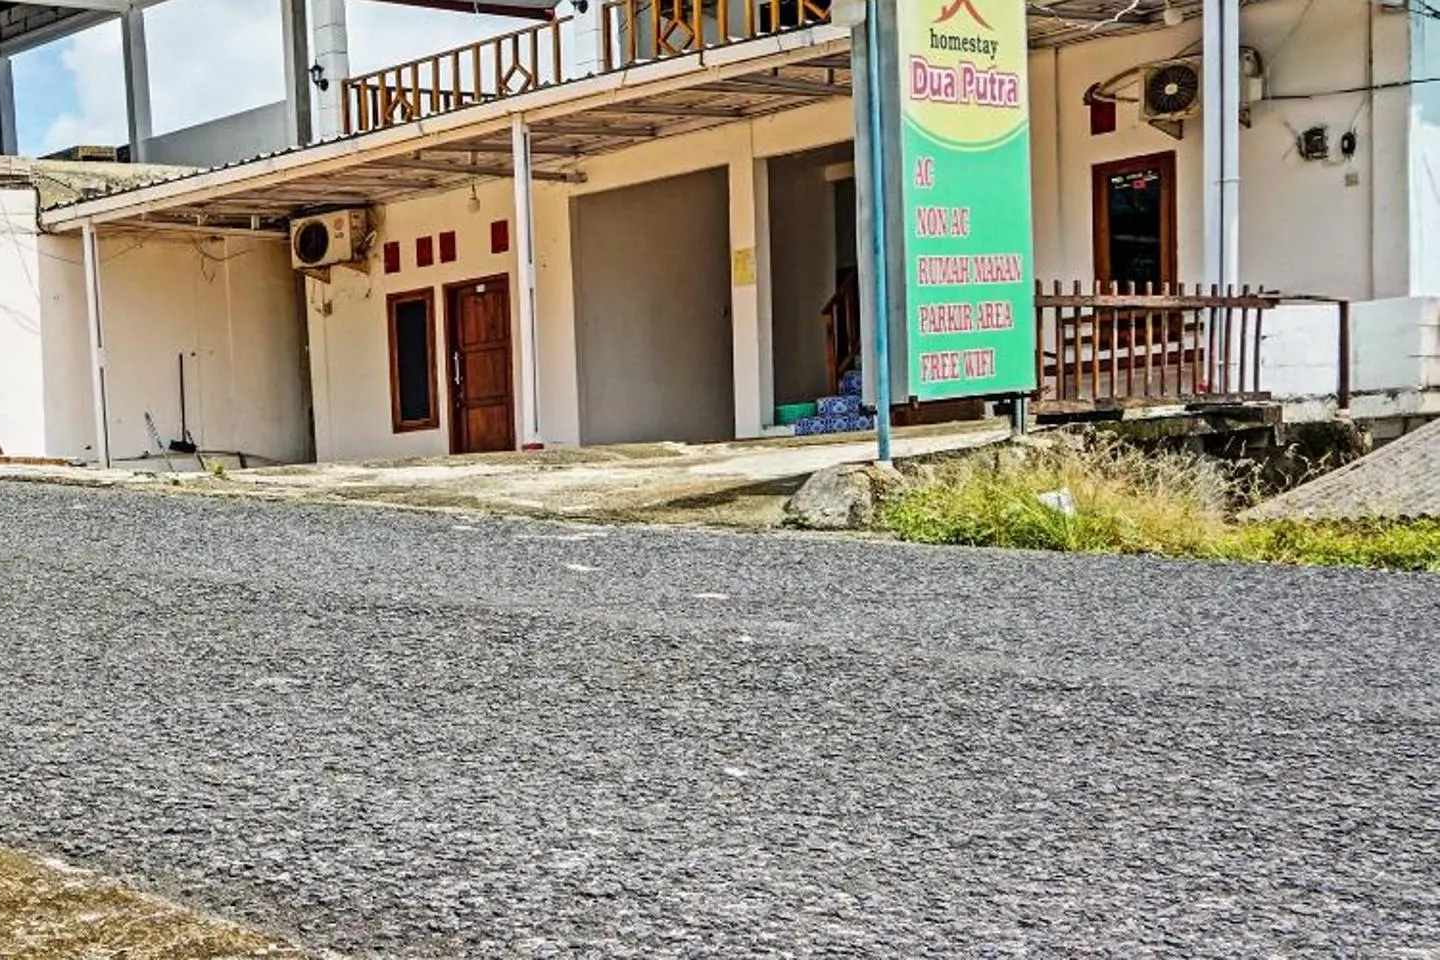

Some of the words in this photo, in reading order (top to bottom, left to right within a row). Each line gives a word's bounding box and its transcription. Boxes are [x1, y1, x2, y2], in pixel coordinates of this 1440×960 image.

[929, 28, 999, 60] homestay
[910, 56, 957, 102] Dua
[960, 62, 1019, 107] Putra
[915, 157, 934, 187] AC
[917, 207, 947, 237] NON
[951, 207, 970, 236] AC
[918, 256, 970, 285] RUMAH
[973, 254, 1021, 283] MAKAN
[919, 304, 972, 333] PARKIR
[977, 301, 1013, 330] AREA
[920, 351, 960, 382] FREE
[963, 348, 995, 377] WIFI
